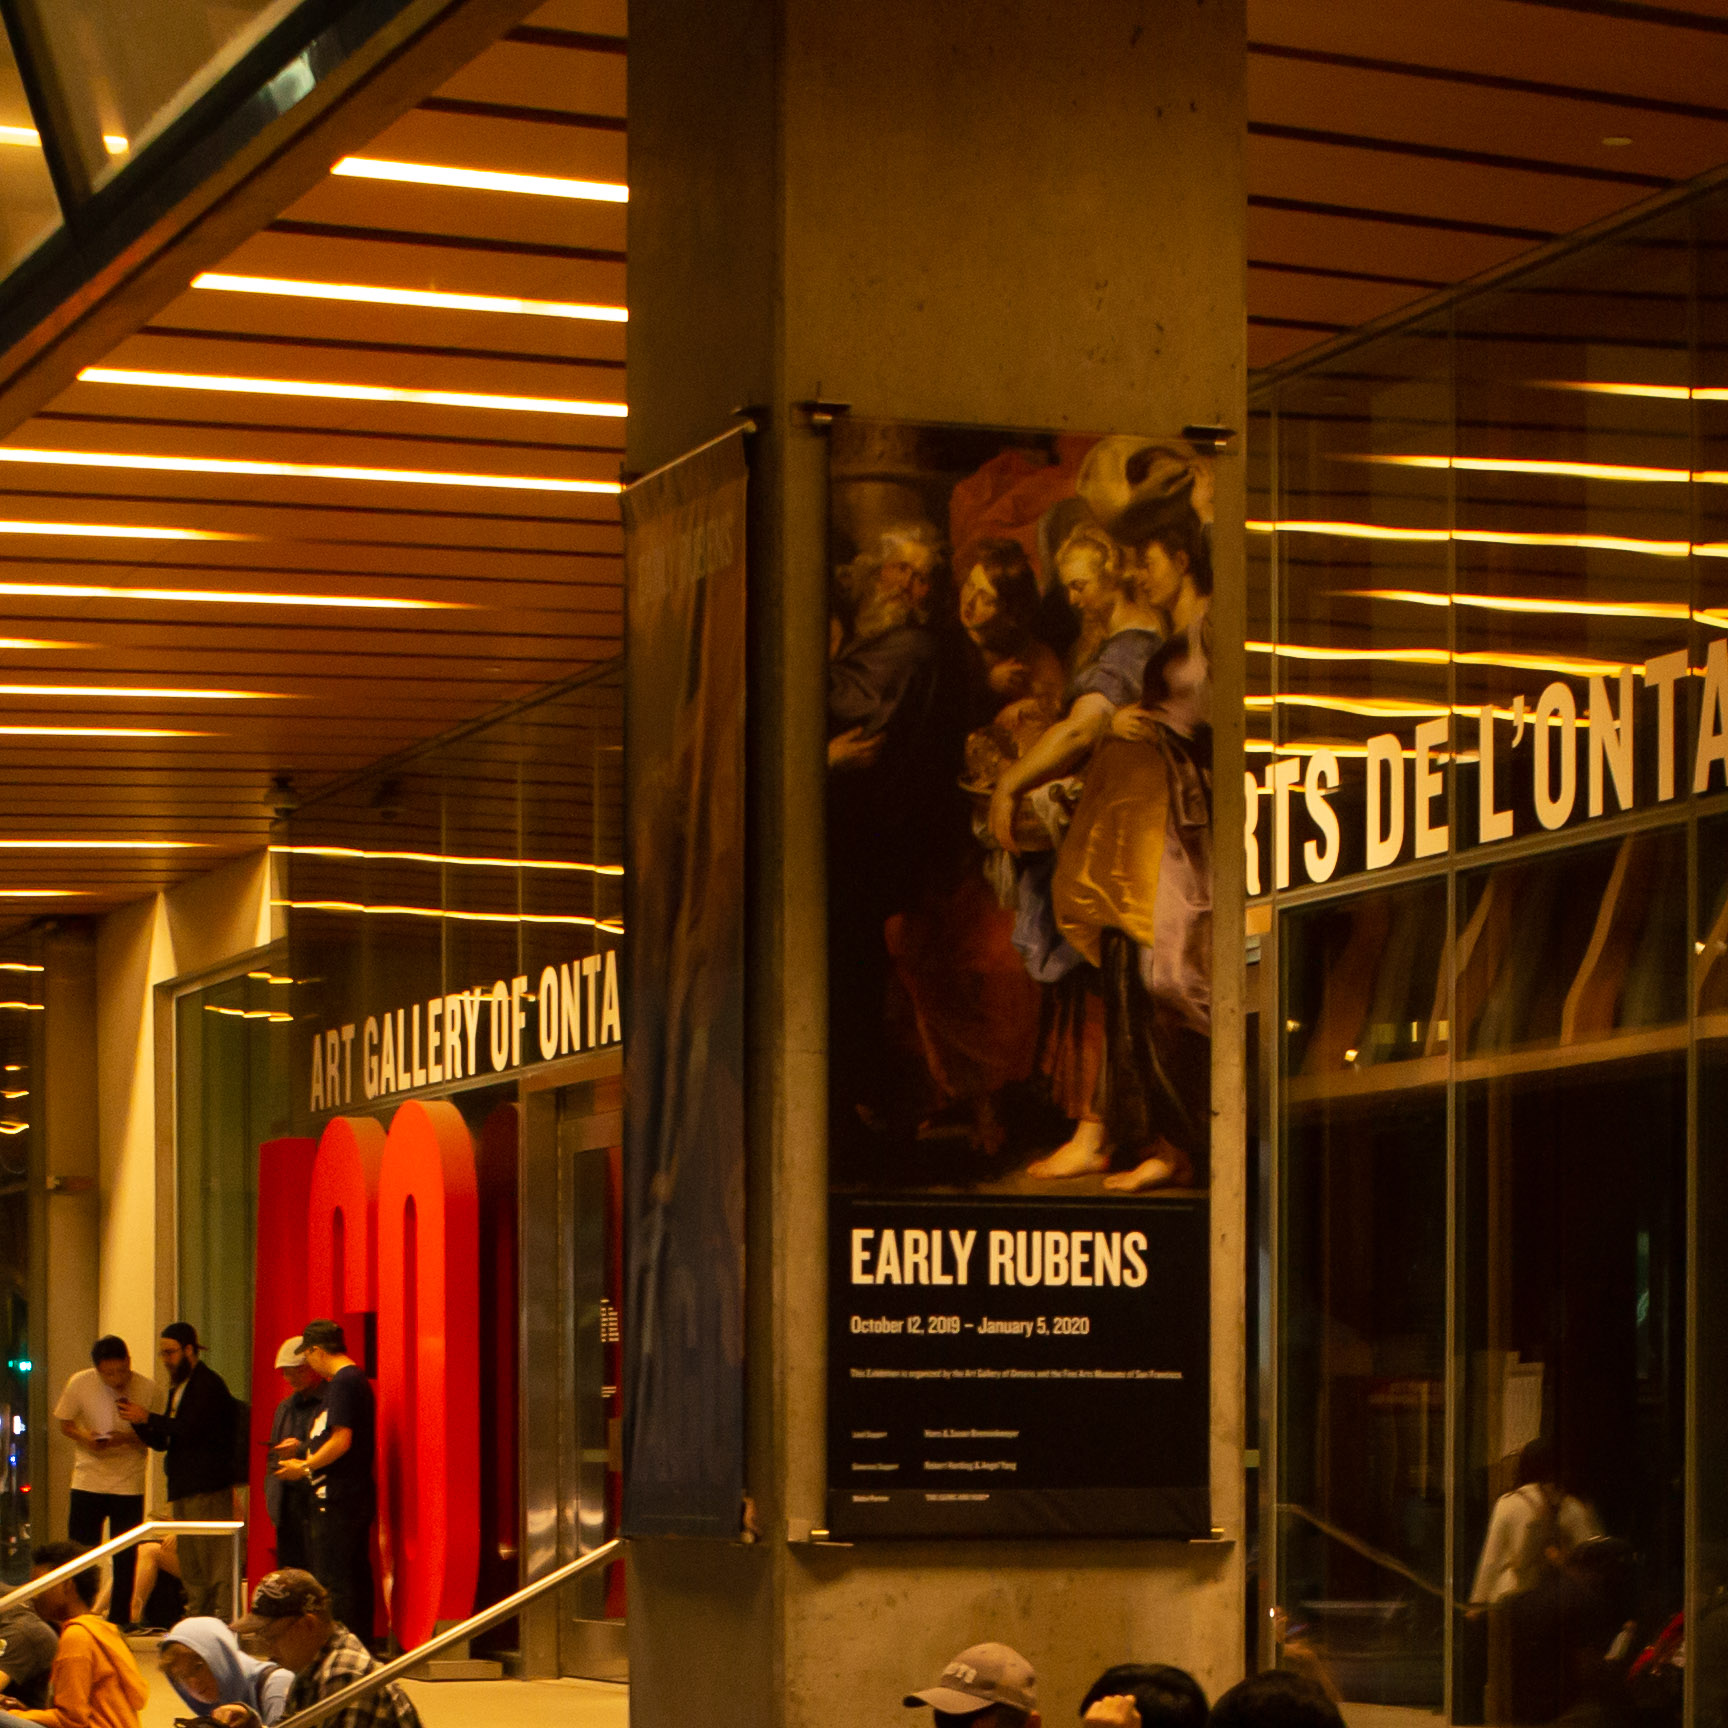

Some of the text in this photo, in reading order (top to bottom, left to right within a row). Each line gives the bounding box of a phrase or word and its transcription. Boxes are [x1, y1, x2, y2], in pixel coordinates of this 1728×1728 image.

[1365, 716, 1450, 872] DE
[310, 949, 622, 1113] ART GALLERY OF ONTA
[850, 1228, 1149, 1289] EARLY RUBENS
[849, 1315, 904, 1335] October
[906, 1315, 925, 1337] 12,
[927, 1315, 961, 1335] 2019
[976, 1315, 1035, 1339] January
[1036, 1316, 1051, 1337] 5,
[1052, 1316, 1091, 1335] 2020
